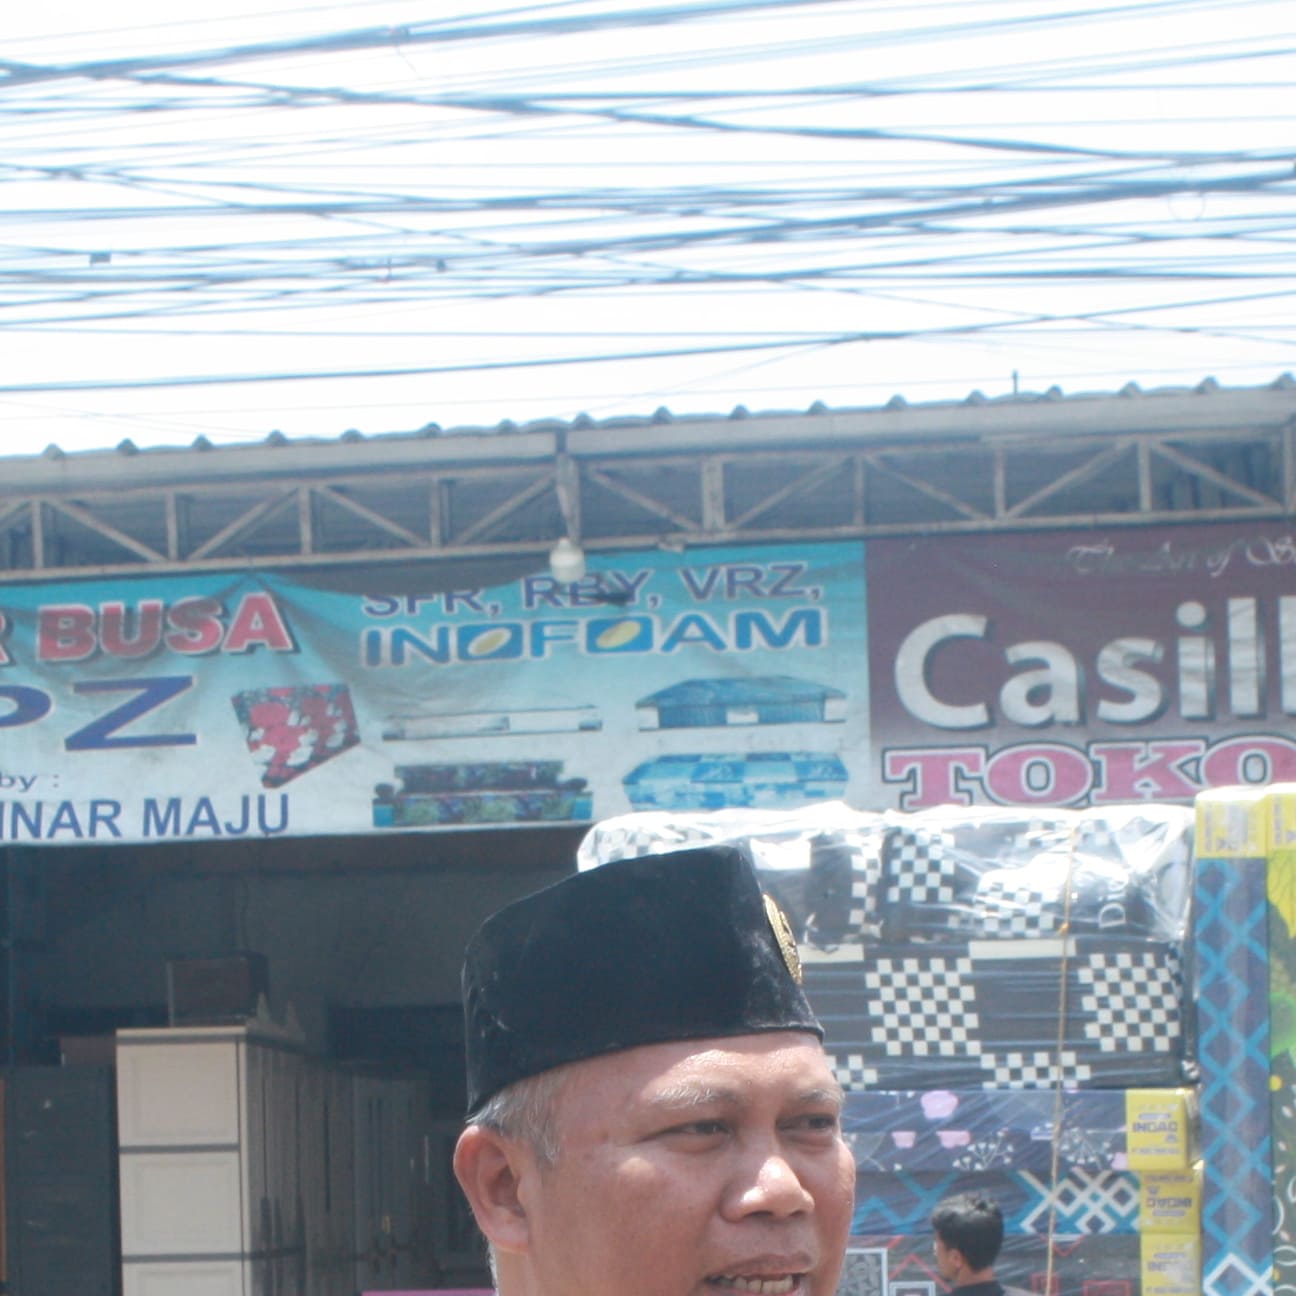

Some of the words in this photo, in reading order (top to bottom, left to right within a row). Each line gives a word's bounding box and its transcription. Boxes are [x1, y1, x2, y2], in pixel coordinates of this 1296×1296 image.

[681, 563, 822, 600] VRZ,
[36, 591, 300, 664] BUSA
[142, 792, 291, 837] MAJU
